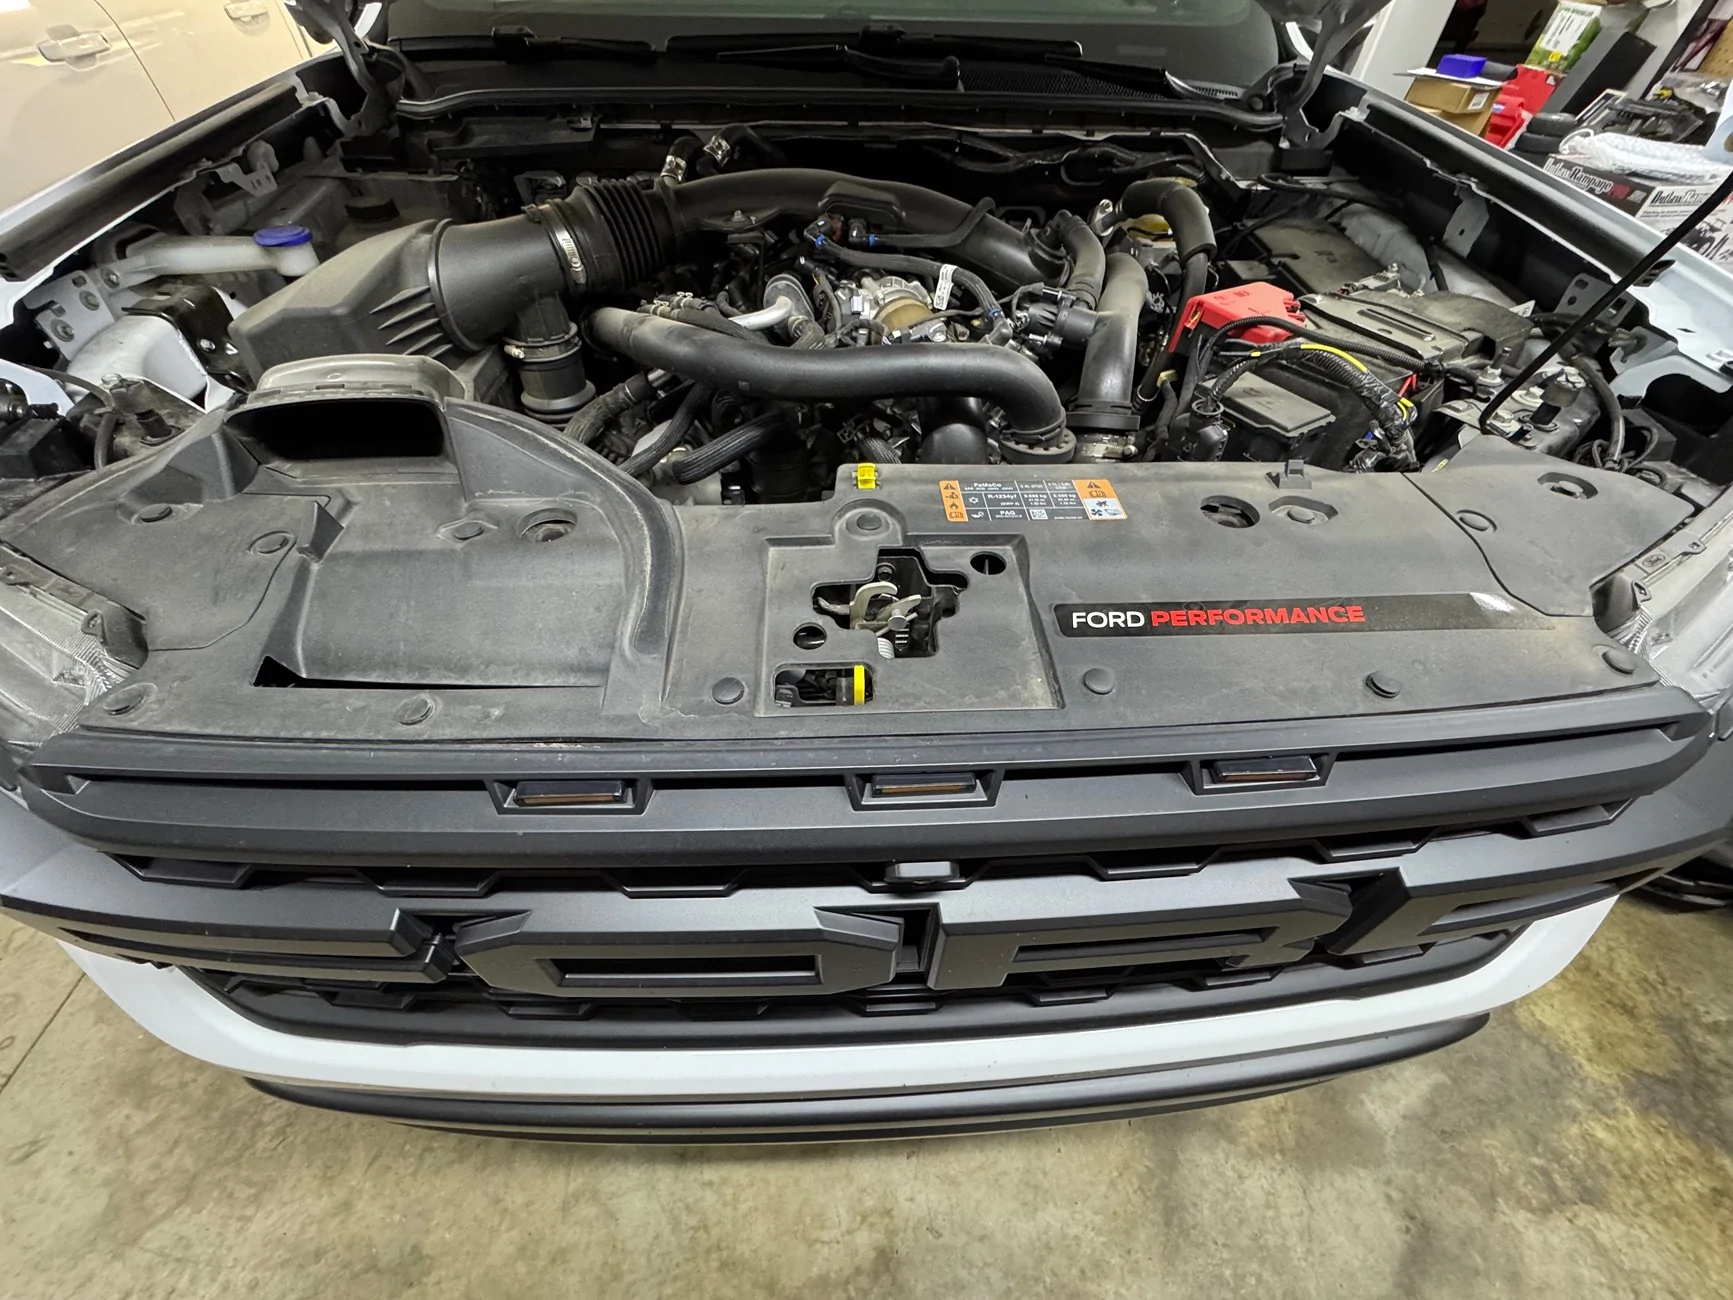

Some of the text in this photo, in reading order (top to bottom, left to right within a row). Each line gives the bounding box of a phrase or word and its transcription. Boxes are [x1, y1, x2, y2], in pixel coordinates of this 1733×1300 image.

[1570, 166, 1614, 195] Rampage
[1071, 604, 1367, 629] FORD PERFORMANCE
